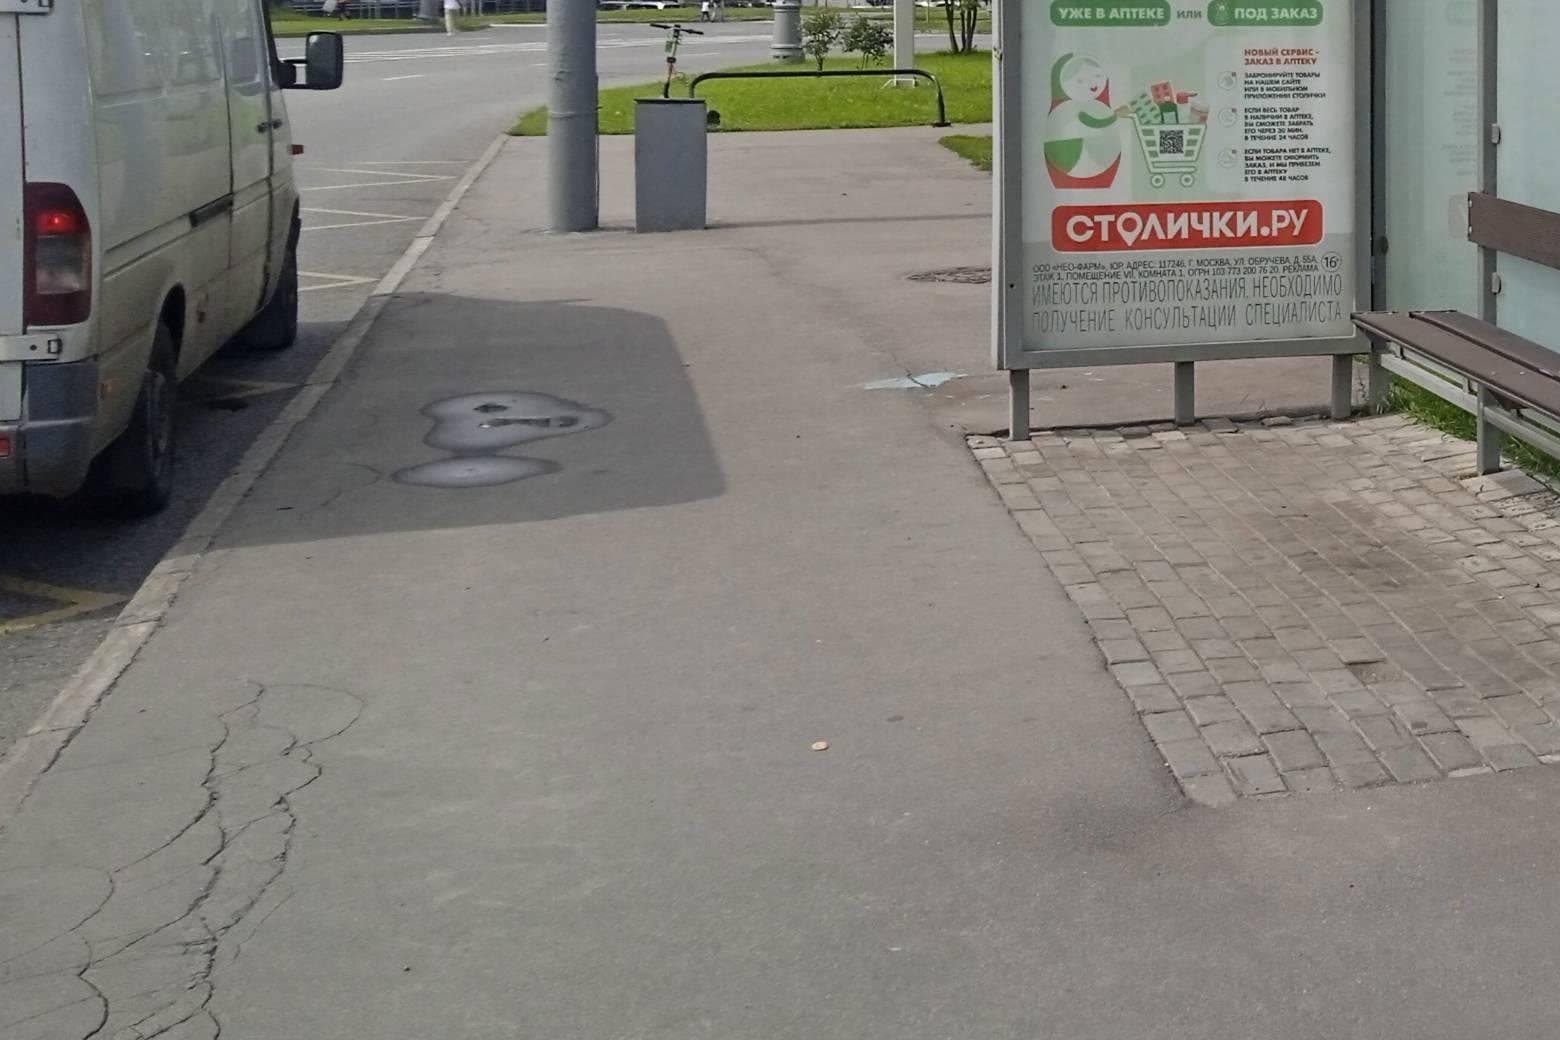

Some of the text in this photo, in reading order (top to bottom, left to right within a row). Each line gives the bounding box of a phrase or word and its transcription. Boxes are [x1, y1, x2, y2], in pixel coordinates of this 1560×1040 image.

[1059, 7, 1318, 21] УЖЕ В АПТЕКЕ ИЛИ ПОД ЗАКАЗ
[1244, 47, 1314, 56] НОВЫЙ СЕРВИС
[1244, 58, 1274, 66] ЗАКАЗ
[1066, 209, 1309, 247] СТОЛИЧКИ.РУ
[1032, 263, 1050, 273] ООО
[1067, 270, 1121, 281] ПОМЕЩЕНИЕ
[1138, 268, 1176, 278] КОМНАТА
[1188, 268, 1210, 277] ОГРН
[1228, 266, 1241, 275] 773
[1282, 263, 1318, 274] РЕКЛАМА
[1032, 282, 1098, 306] ИМЕЮТСЯ
[1253, 274, 1342, 299] НЕОБХОДИМО
[1032, 300, 1342, 333] ПОЛУЧЕНИЕ КОНСУЛЬТАЦИИ СПЕЦИАЛИСТА
